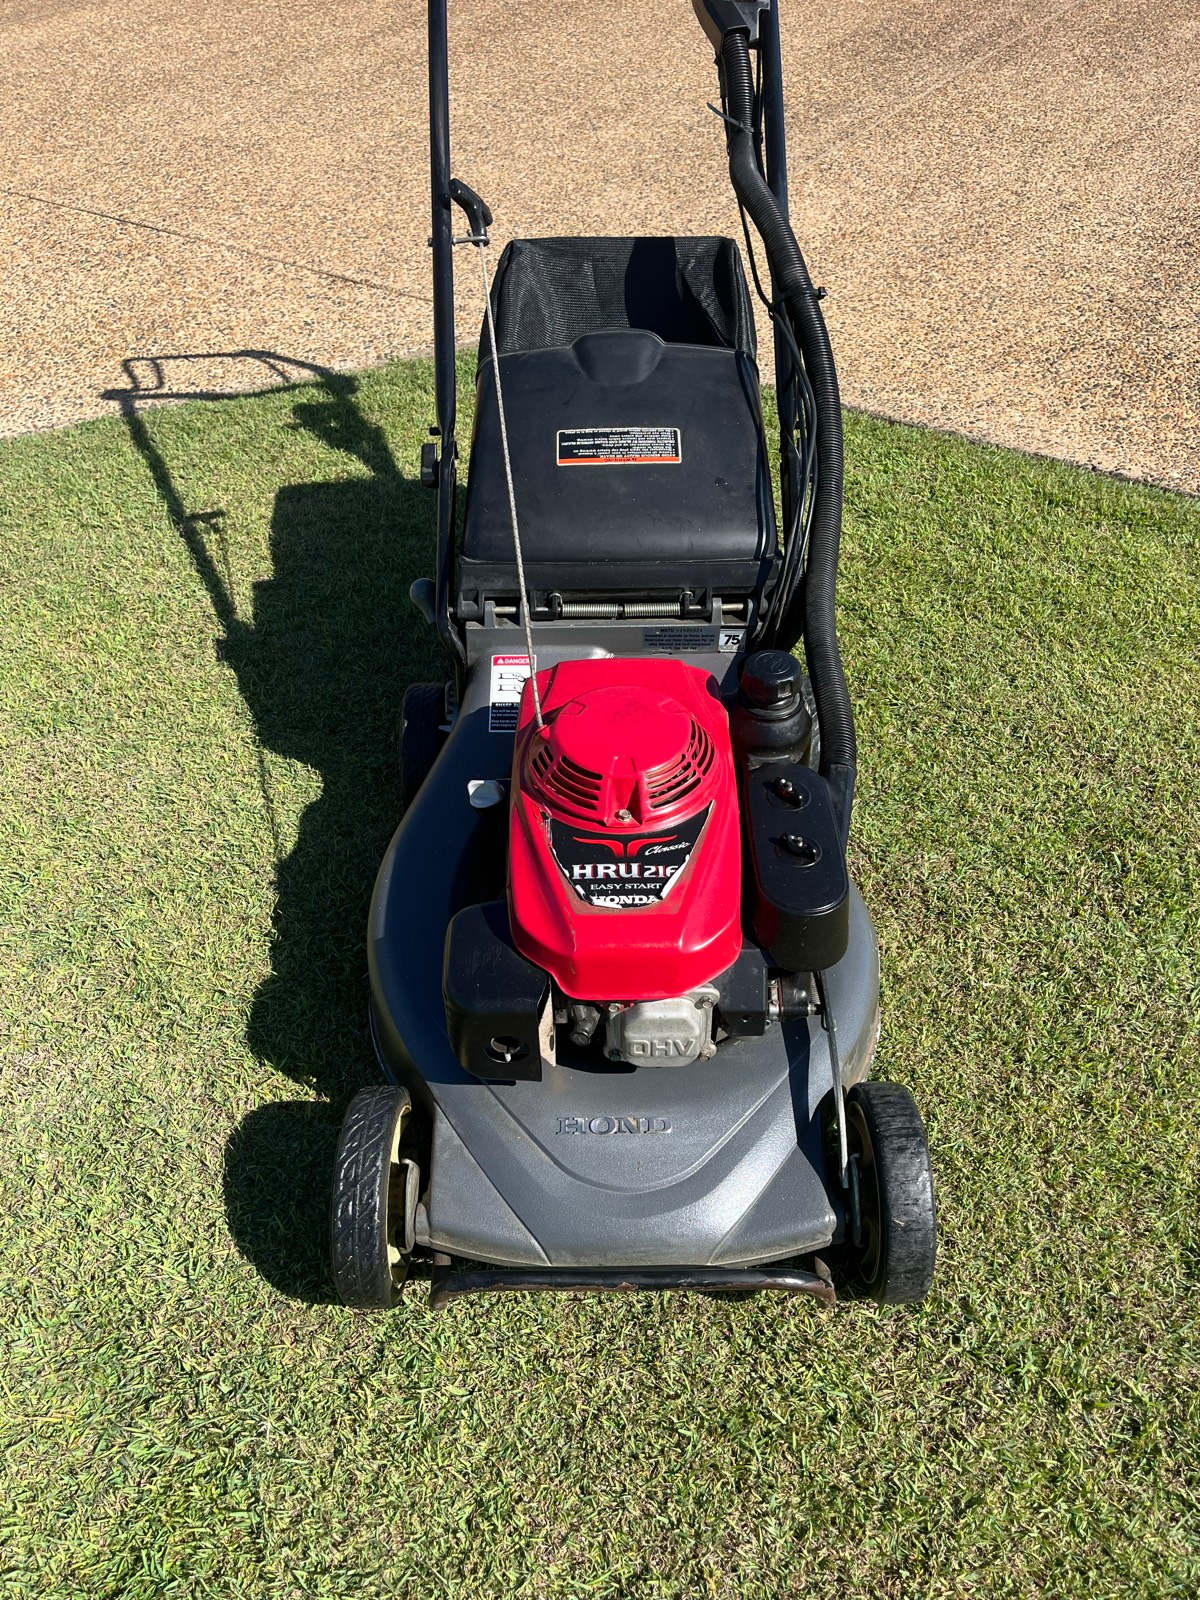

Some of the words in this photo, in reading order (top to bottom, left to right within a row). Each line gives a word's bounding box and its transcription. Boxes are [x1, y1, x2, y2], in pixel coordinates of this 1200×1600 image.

[724, 634, 740, 645] 75
[644, 841, 692, 856] Classic
[571, 862, 641, 880] HRU
[590, 883, 622, 891] EASY
